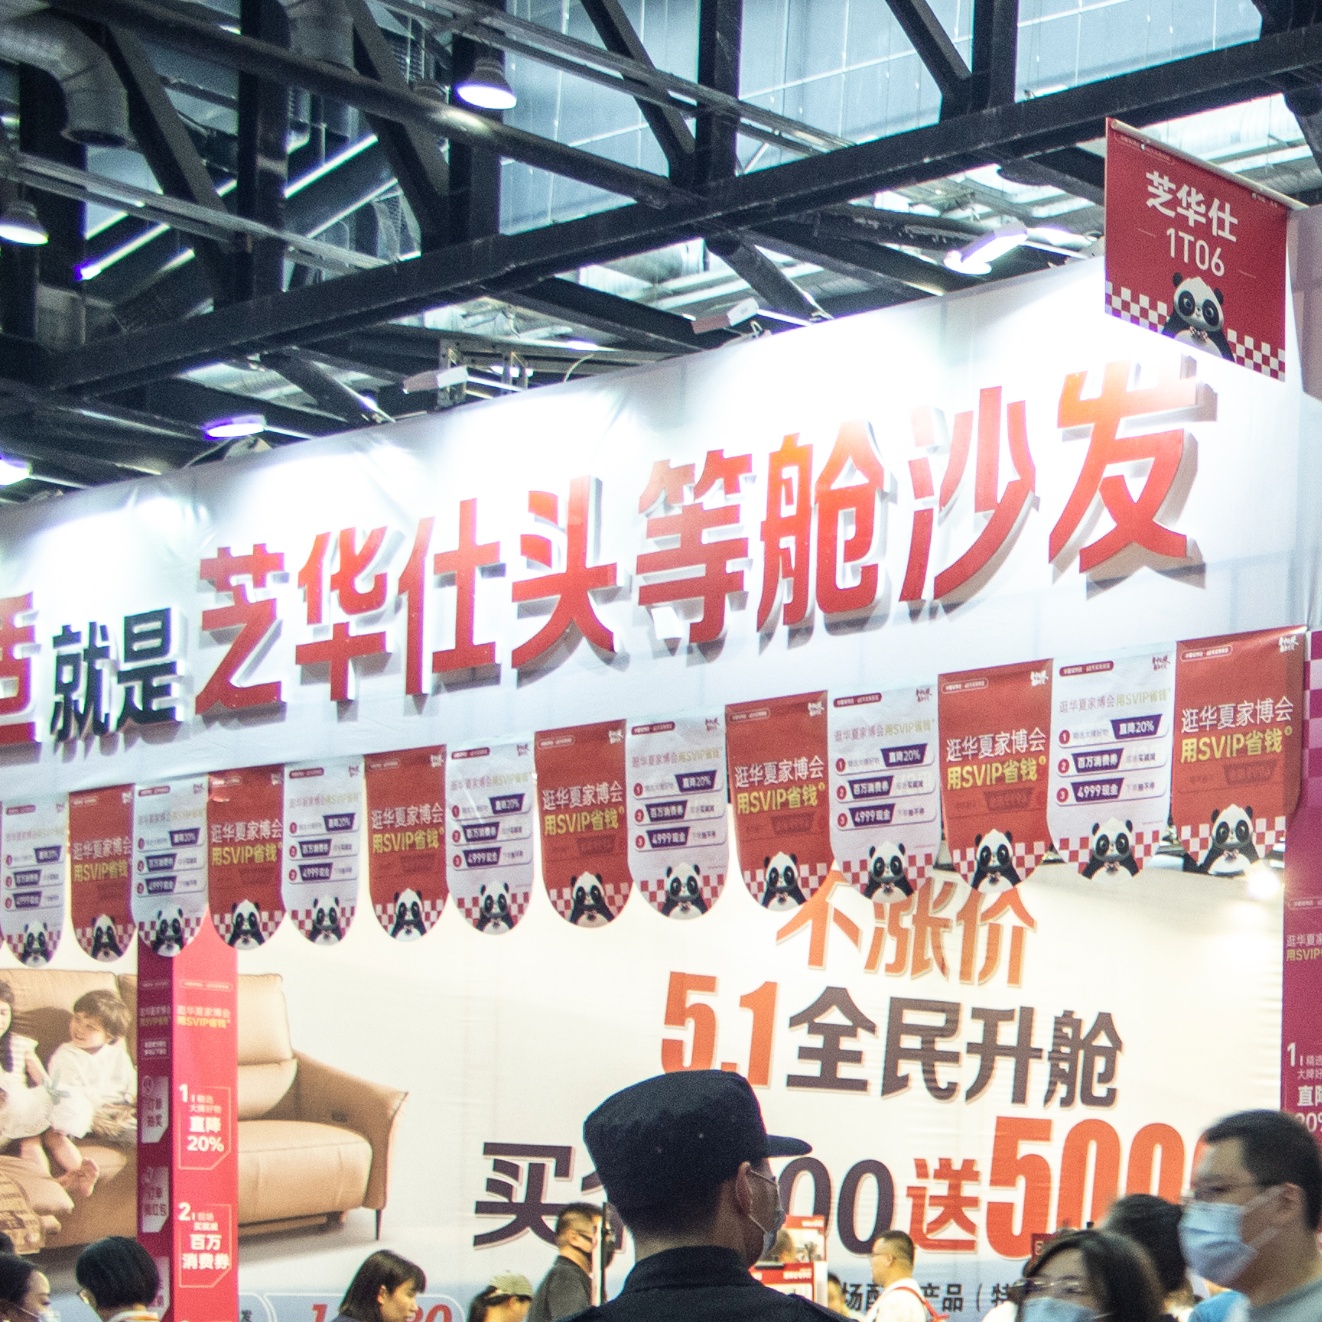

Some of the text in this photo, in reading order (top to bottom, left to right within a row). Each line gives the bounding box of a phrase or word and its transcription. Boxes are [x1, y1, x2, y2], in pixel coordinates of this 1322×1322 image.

[1146, 171, 1238, 242] 芝华仕
[1167, 228, 1225, 276] 1T06
[1181, 696, 1294, 734] 逛华夏家博会
[1118, 721, 1154, 737] 直降20%
[946, 727, 1046, 762] 逛华夏家博会
[888, 750, 921, 764] 直降20%
[1077, 755, 1118, 771] 百万消费券
[735, 755, 824, 788] 逛华夏家博会
[543, 781, 623, 810] 逛华夏家博会
[852, 782, 890, 796] 百万消费券
[1077, 783, 1119, 799] 4999现金
[371, 803, 443, 830] 逛华夏家博会
[854, 810, 891, 824] 4999现金
[652, 831, 686, 845] 4999现金
[1287, 1042, 1297, 1067] 1
[179, 1084, 188, 1103] 1
[187, 1135, 225, 1152] 20%
[178, 1202, 191, 1221] 2
[190, 1233, 222, 1251] 百万
[181, 1252, 229, 1270] 消费券
